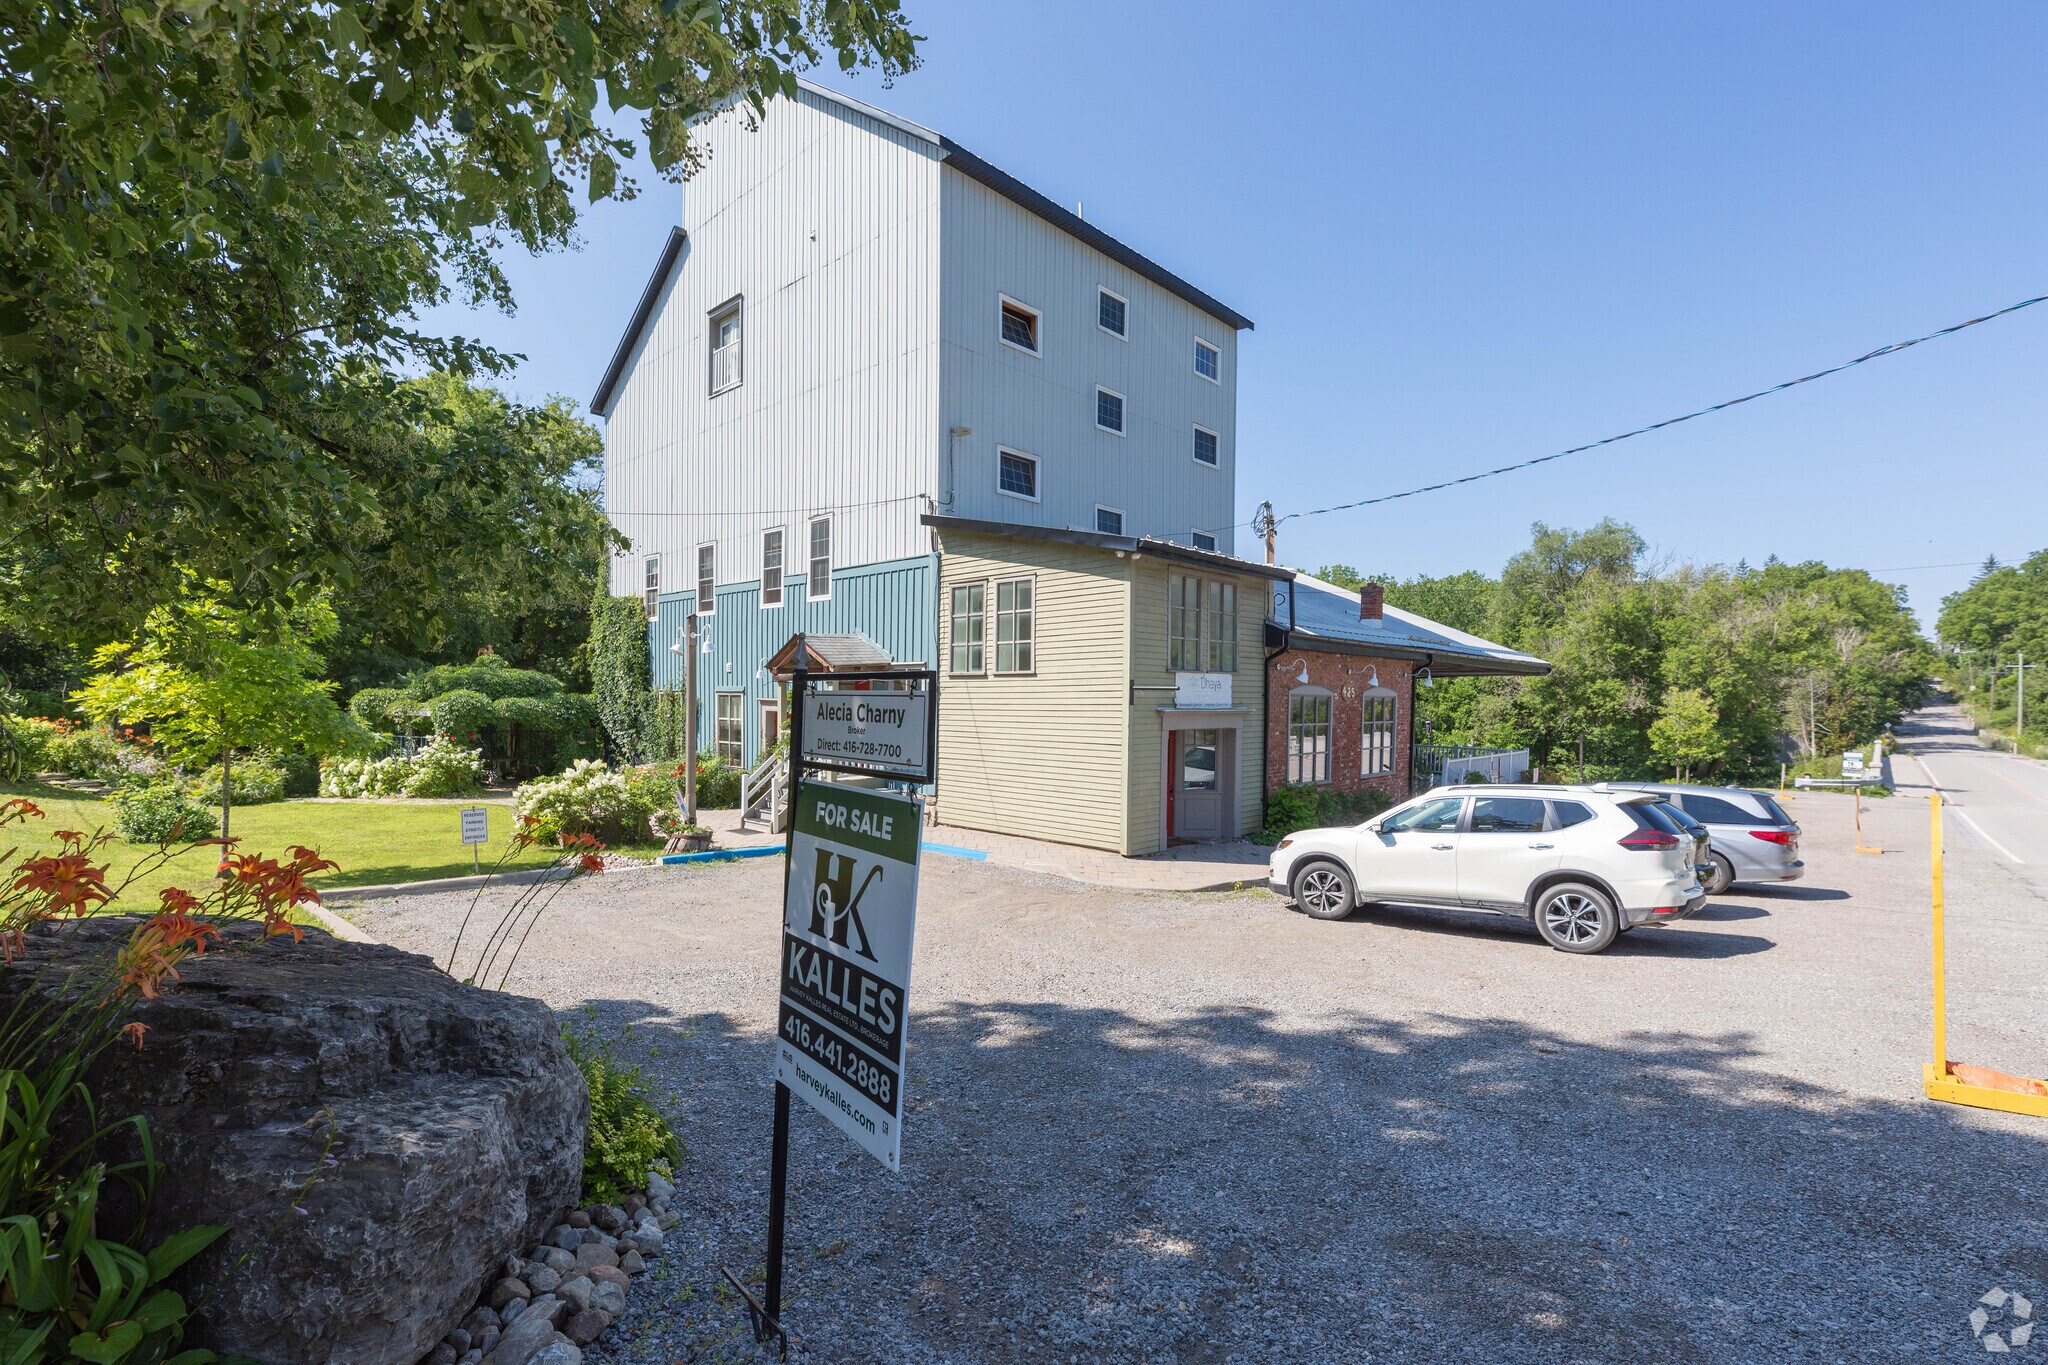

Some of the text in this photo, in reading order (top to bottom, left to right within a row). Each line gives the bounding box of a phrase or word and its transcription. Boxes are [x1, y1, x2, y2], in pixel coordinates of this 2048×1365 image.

[1342, 686, 1355, 698] 425
[817, 702, 906, 728] Alecia Charny
[847, 726, 866, 735] Broker
[817, 738, 902, 758] Direct: 416-728-7700
[815, 801, 894, 840] FOR SALE
[788, 941, 896, 1035] KALLES
[790, 985, 806, 998] HARVEY
[805, 994, 821, 1009] KALLES
[821, 1003, 833, 1016] REAL
[833, 1010, 849, 1025] ESTATE
[860, 1025, 890, 1050] BROKERAGE
[785, 1015, 891, 1104] 416.441.2888
[795, 1063, 876, 1135] harveykalles.com
